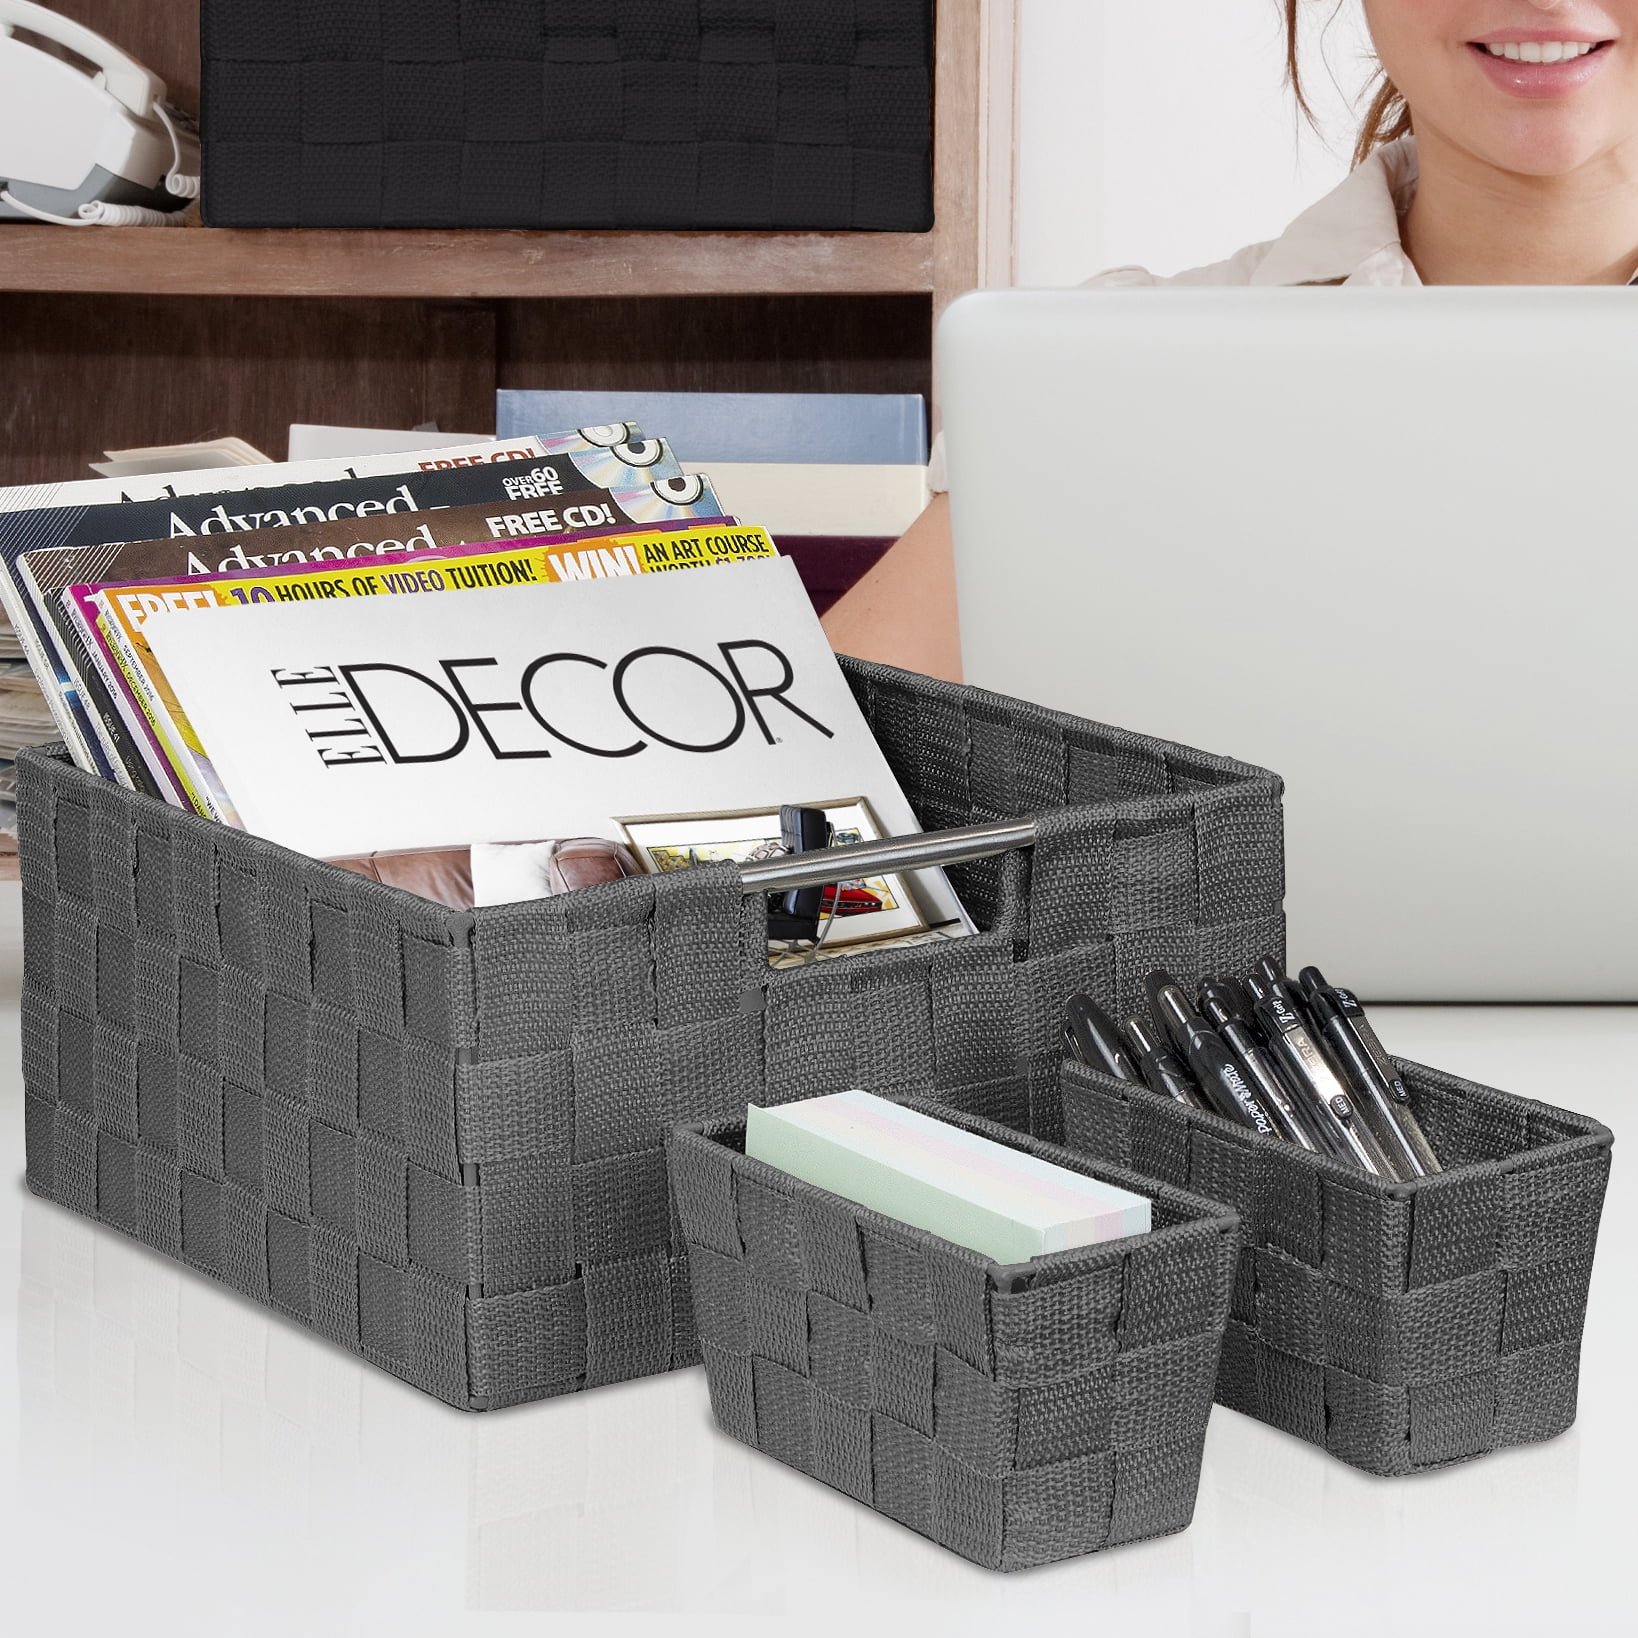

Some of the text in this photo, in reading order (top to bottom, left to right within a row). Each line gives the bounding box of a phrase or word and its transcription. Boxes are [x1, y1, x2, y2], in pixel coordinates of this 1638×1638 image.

[502, 466, 559, 487] OVER 60
[503, 480, 564, 501] FREE
[169, 485, 418, 539] Advanced
[485, 503, 617, 538] FREE CD!
[548, 545, 643, 583] WIN!
[642, 543, 670, 564] AN
[672, 538, 705, 561] ART
[705, 534, 770, 556] COURSE
[230, 586, 276, 605] 10
[275, 579, 349, 601] HOURS
[352, 576, 380, 598] OF
[380, 569, 445, 595] VIDEO
[445, 558, 538, 590] TUITION!
[270, 665, 389, 769] ELLE
[337, 639, 835, 765] DECOR
[1335, 1097, 1350, 1115] MED
[1394, 1080, 1407, 1098] MED
